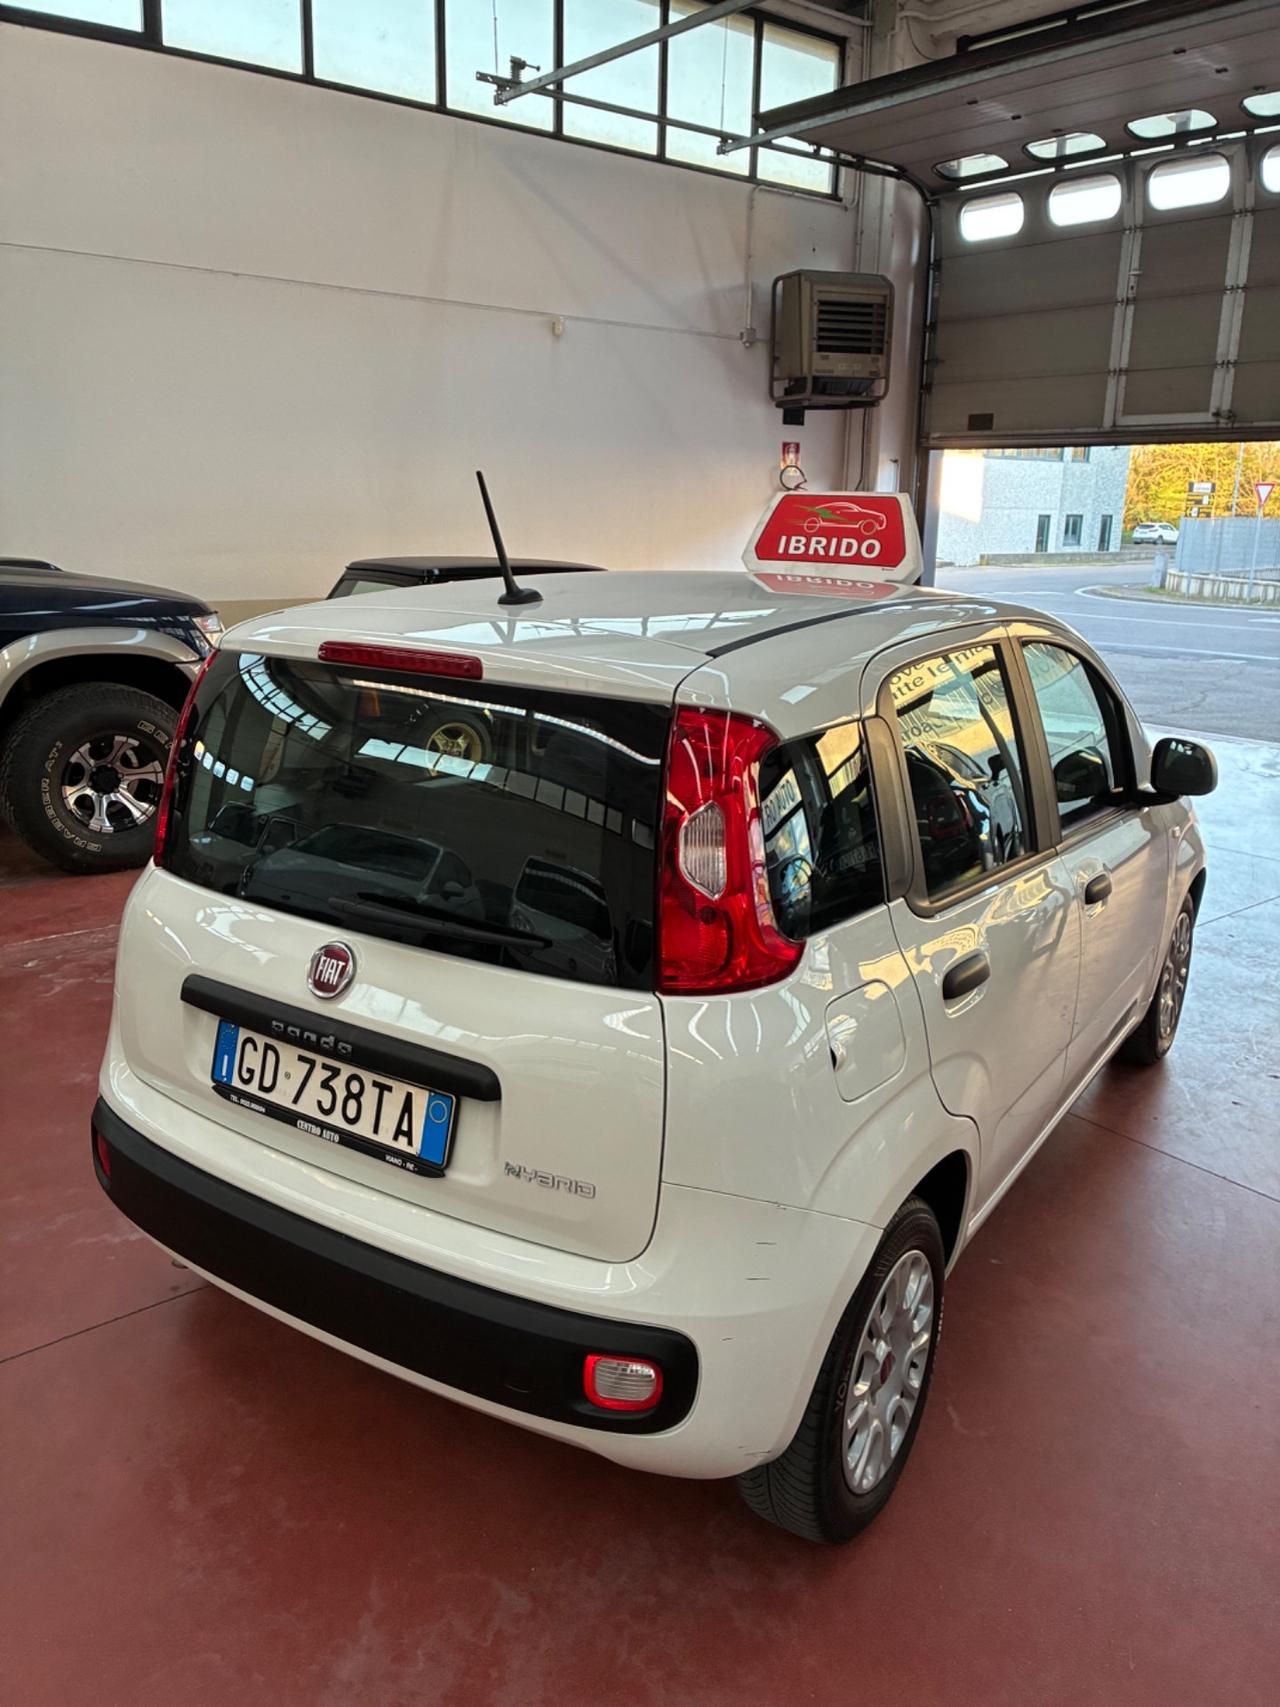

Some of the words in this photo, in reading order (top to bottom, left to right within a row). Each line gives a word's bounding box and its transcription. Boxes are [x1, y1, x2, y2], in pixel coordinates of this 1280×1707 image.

[777, 535, 881, 559] IBRIDO
[315, 956, 346, 986] FIAT
[271, 1019, 353, 1057] panda
[237, 1037, 281, 1094] GD
[292, 1054, 414, 1147] 738TA
[296, 1119, 321, 1136] CENTRO
[322, 1129, 340, 1143] AUTO
